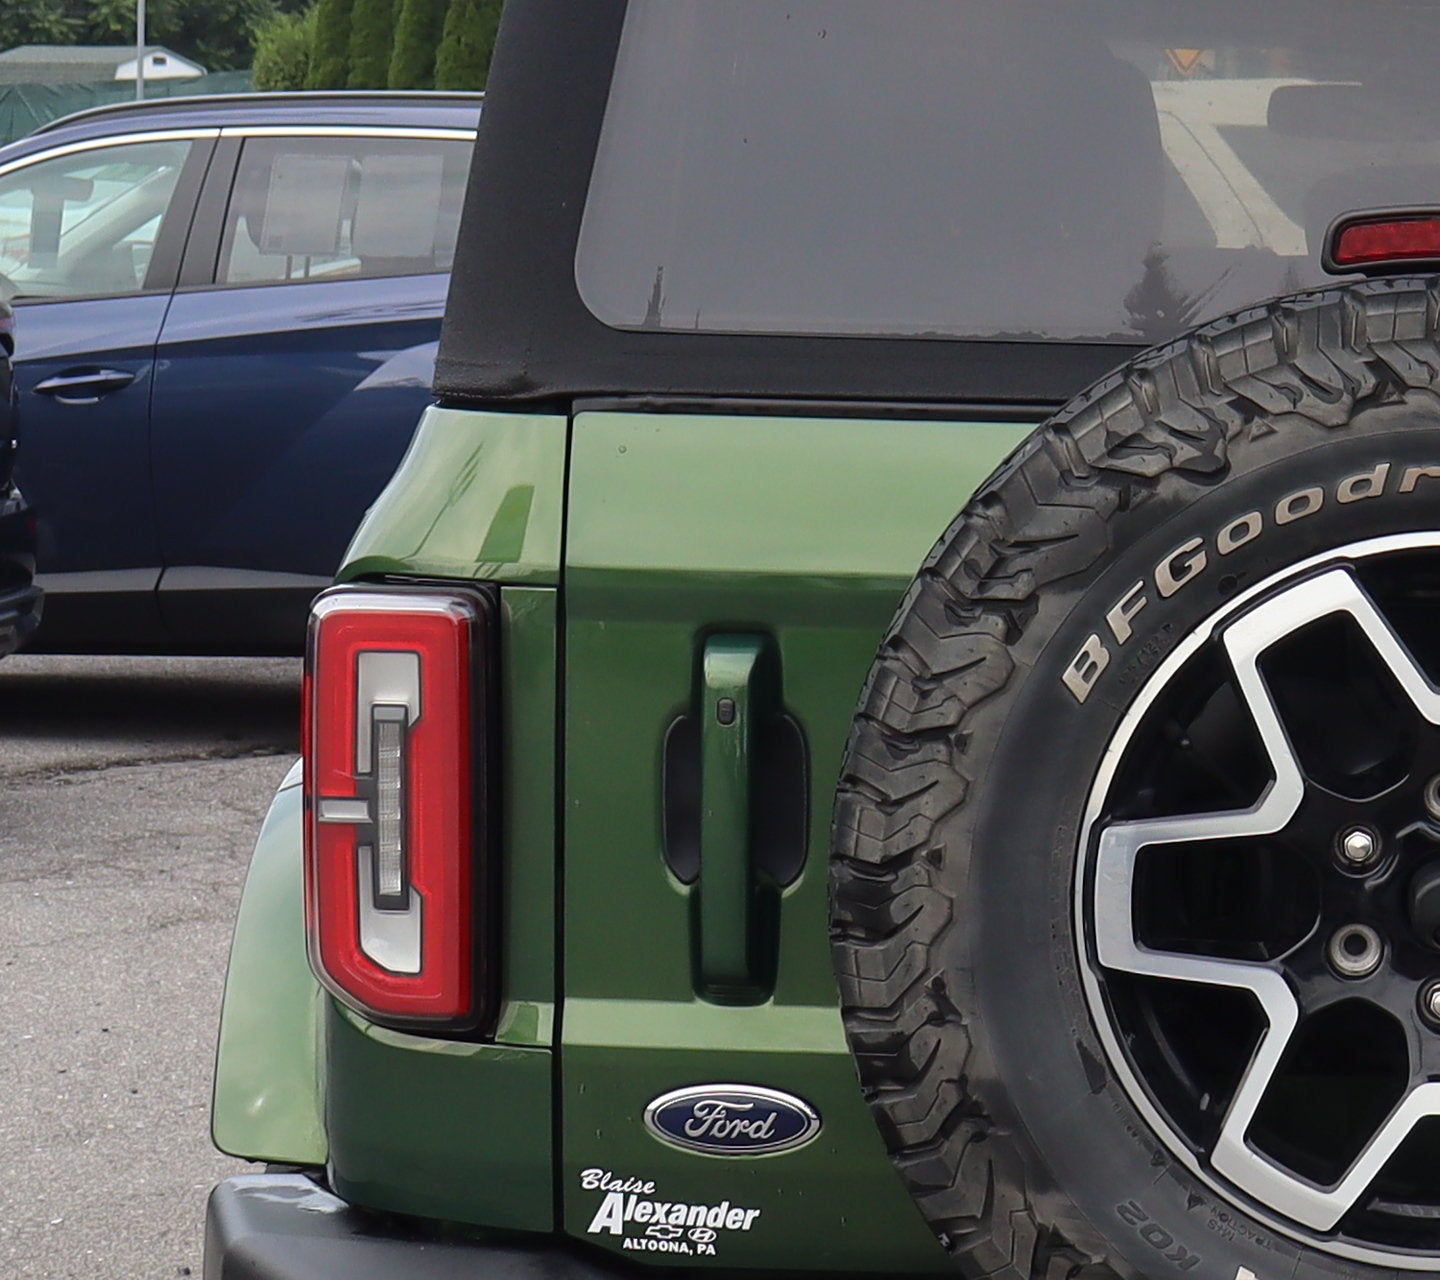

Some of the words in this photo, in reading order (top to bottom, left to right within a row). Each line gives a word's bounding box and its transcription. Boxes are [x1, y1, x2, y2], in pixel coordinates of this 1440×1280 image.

[684, 1100, 777, 1139] Ford
[580, 1168, 655, 1194] Blaise
[587, 1192, 760, 1235] Alexander
[623, 1237, 694, 1256] ALTOONA,
[697, 1244, 716, 1255] PA
